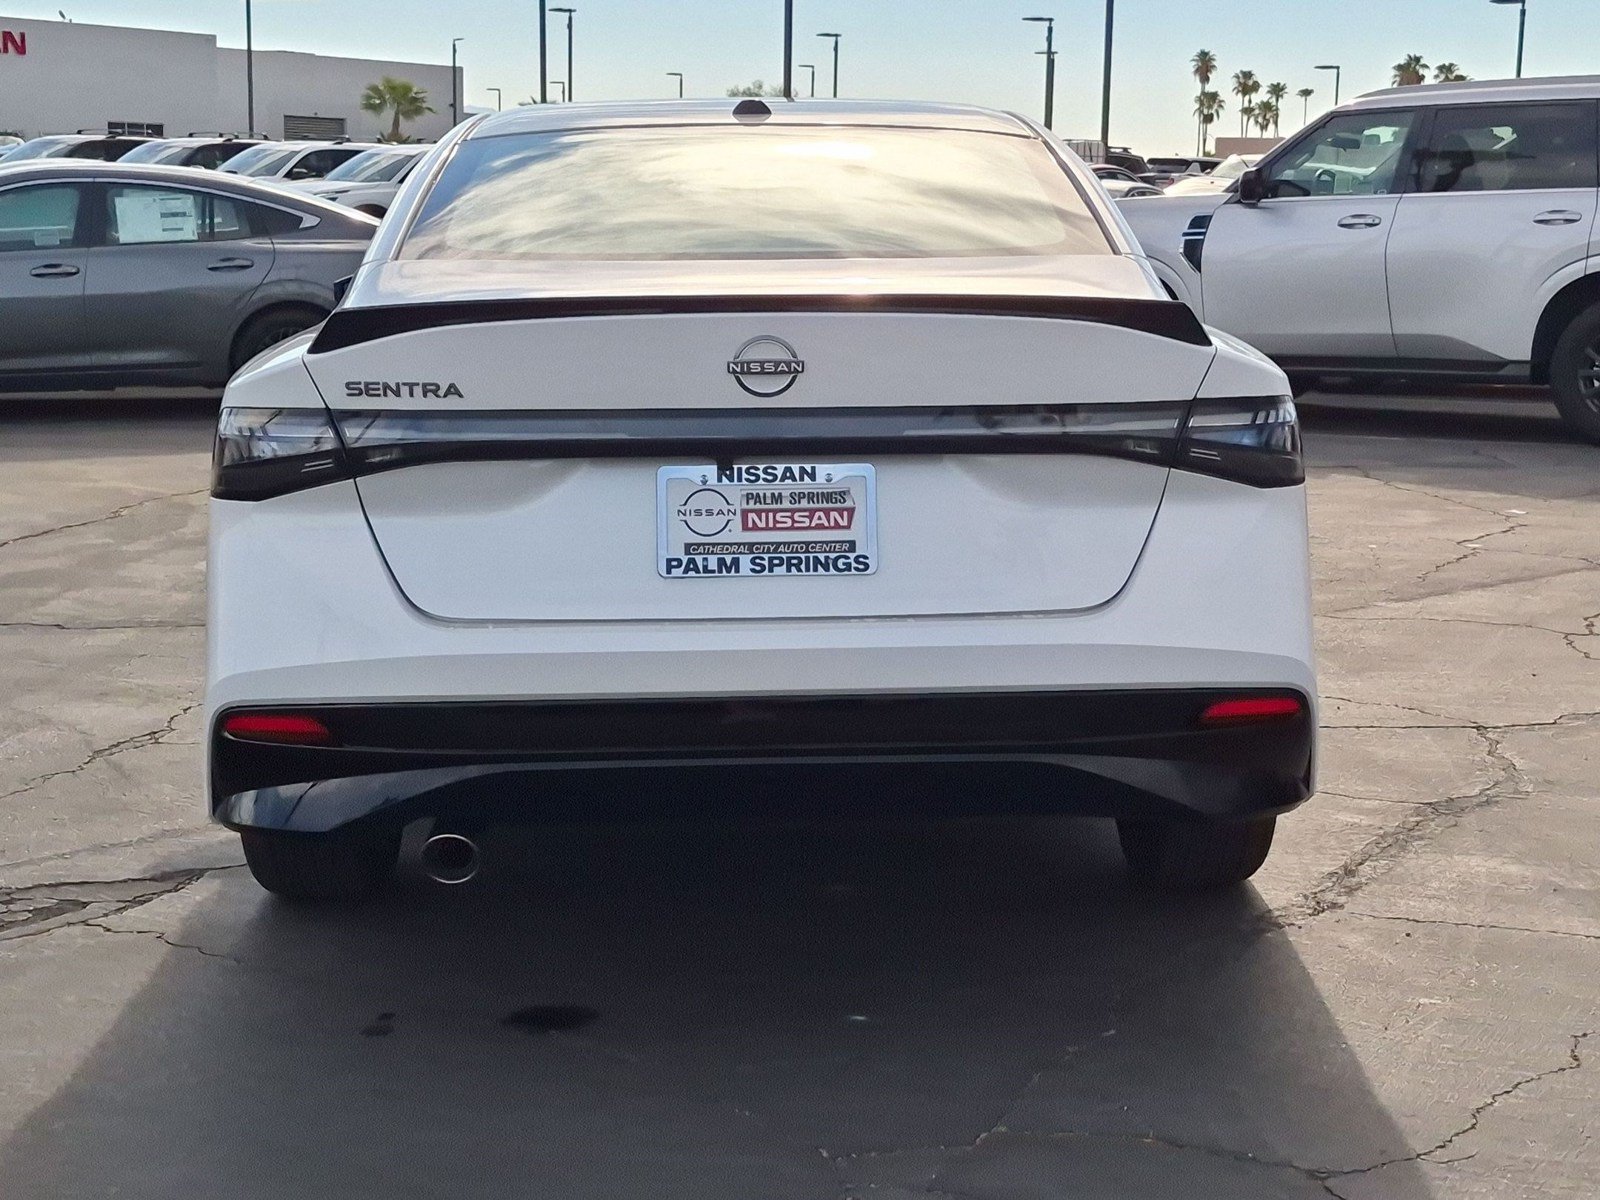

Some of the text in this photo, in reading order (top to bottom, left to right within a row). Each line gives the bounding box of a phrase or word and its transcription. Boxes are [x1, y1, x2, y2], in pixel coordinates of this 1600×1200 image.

[0, 31, 26, 55] N
[729, 362, 803, 373] NISSAN
[345, 381, 464, 398] SENTRA
[717, 465, 816, 483] NISSAN
[745, 490, 847, 505] PALM SPRINGS
[677, 508, 737, 517] NISSAN
[747, 510, 848, 528] NISSAN
[690, 543, 849, 554] CATHEDRAL CITY AUTO CENTER
[666, 555, 870, 574] PALM SPRINGS
